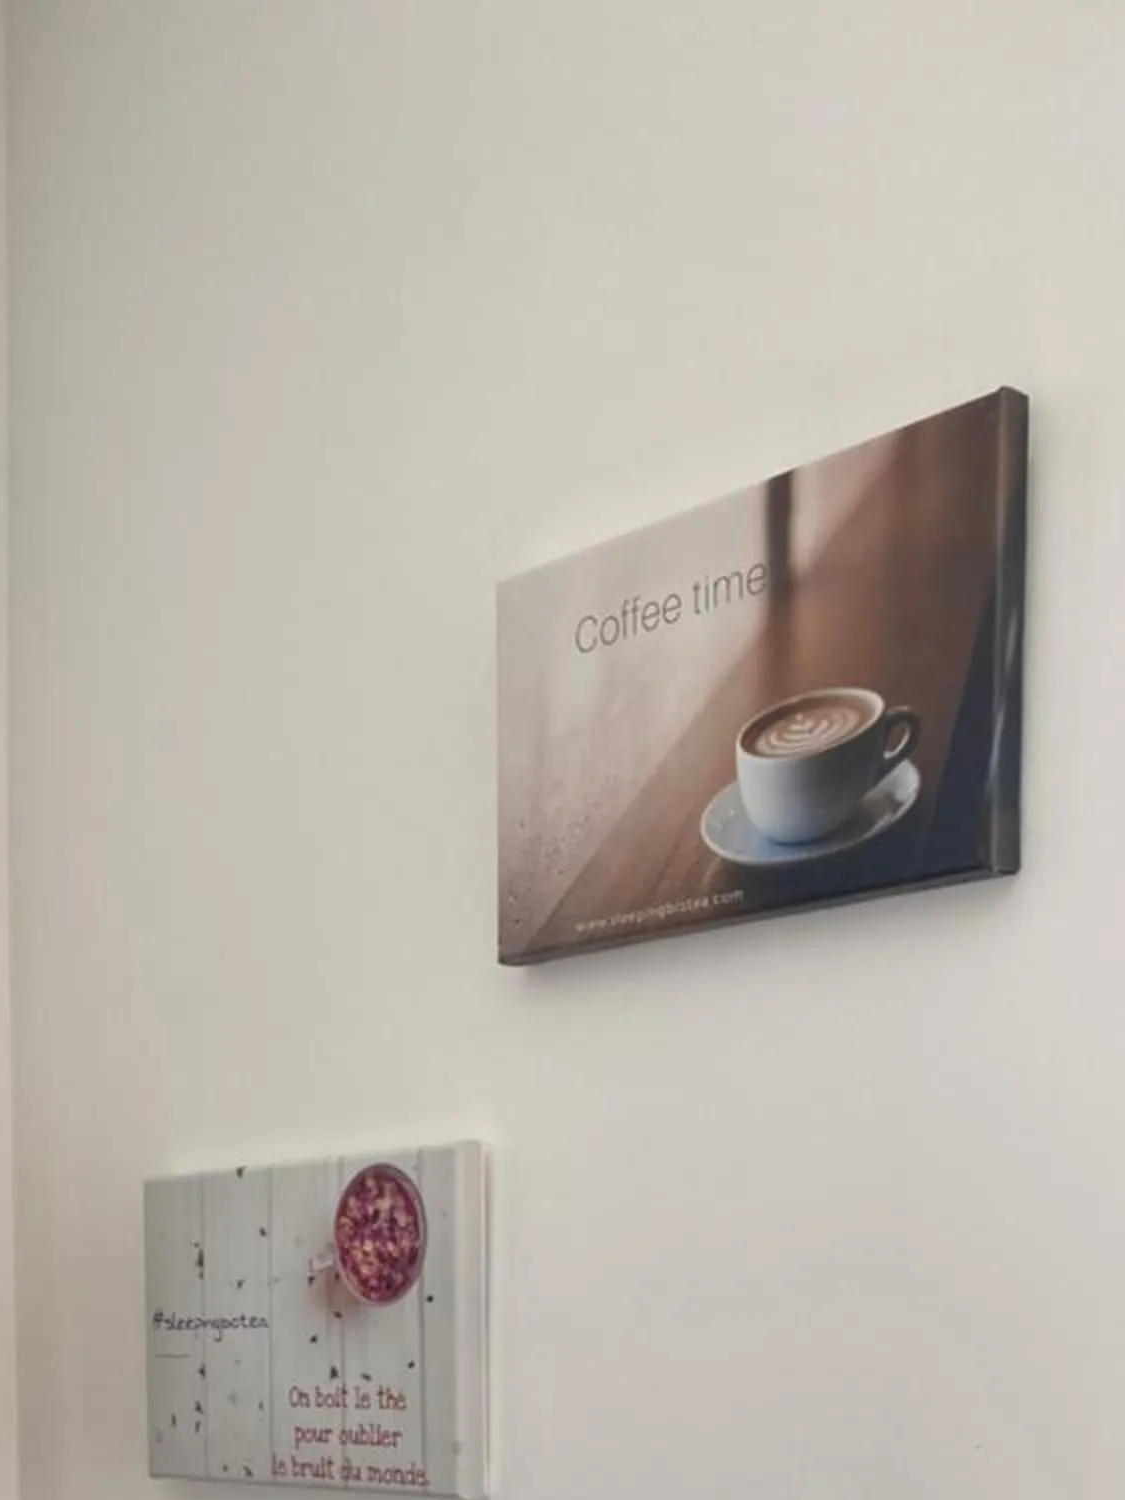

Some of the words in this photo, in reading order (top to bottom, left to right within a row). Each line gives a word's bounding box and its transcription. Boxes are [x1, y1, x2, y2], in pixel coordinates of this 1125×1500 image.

[575, 592, 682, 654] Coffee
[692, 563, 767, 616] time
[288, 1385, 310, 1408] On
[294, 1426, 333, 1450] pour
